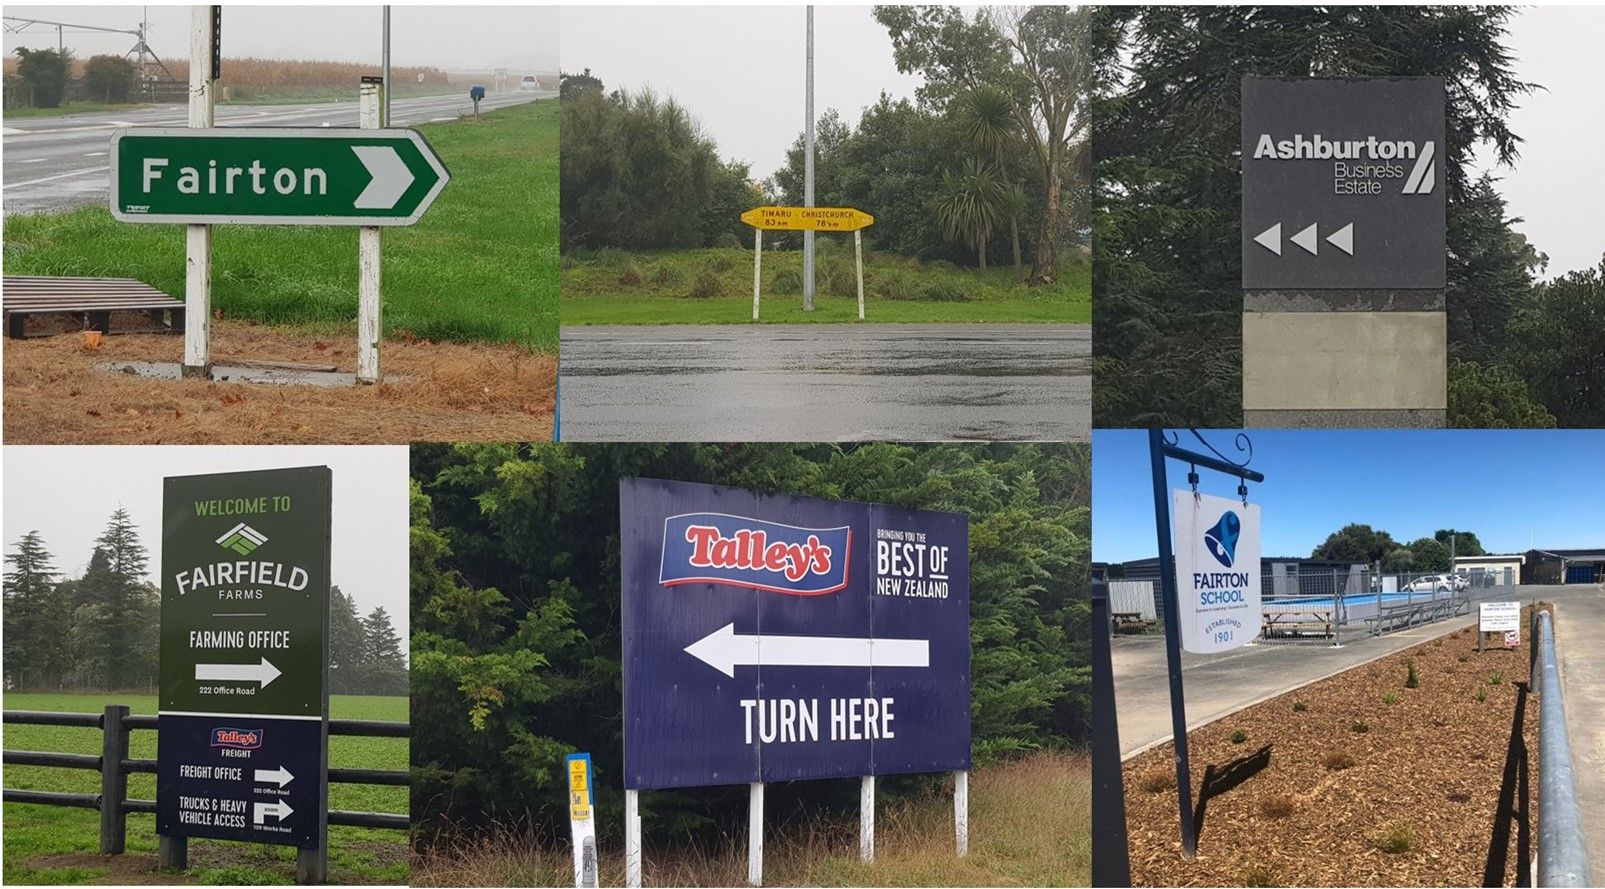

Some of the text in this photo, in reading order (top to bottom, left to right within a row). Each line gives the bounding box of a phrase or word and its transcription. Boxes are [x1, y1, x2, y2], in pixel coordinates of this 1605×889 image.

[1253, 134, 1415, 159] Ashburton
[143, 158, 327, 195] Fairton
[1334, 162, 1404, 178] Business
[1334, 179, 1382, 194] Estate
[801, 210, 853, 218] CHRISTCHURCH
[195, 496, 291, 516] WELCOME TO
[877, 528, 926, 543] BRINGING YOU THE
[685, 524, 831, 581] Talley's
[877, 540, 949, 578] BEST OF
[175, 561, 309, 595] FAIRFIELD
[1193, 573, 1248, 589] FAIRTON
[218, 589, 263, 600] FARMS
[877, 577, 949, 599] NEW ZEALAND
[1200, 590, 1244, 605] SCHOOL
[1205, 618, 1242, 634] ESTABLISHED
[190, 630, 290, 649] FARMING OFFICE
[1215, 631, 1233, 643] 1901
[199, 686, 255, 696] 222 Office Road
[740, 698, 895, 744] TURN HERE
[217, 730, 257, 745] Talley's
[221, 749, 252, 758] FREIGHT
[180, 765, 242, 781] FREIGHT OFFICE
[179, 796, 247, 814] TRUCKS & HEAVY
[179, 811, 246, 828] VEHICLE ACCESS
